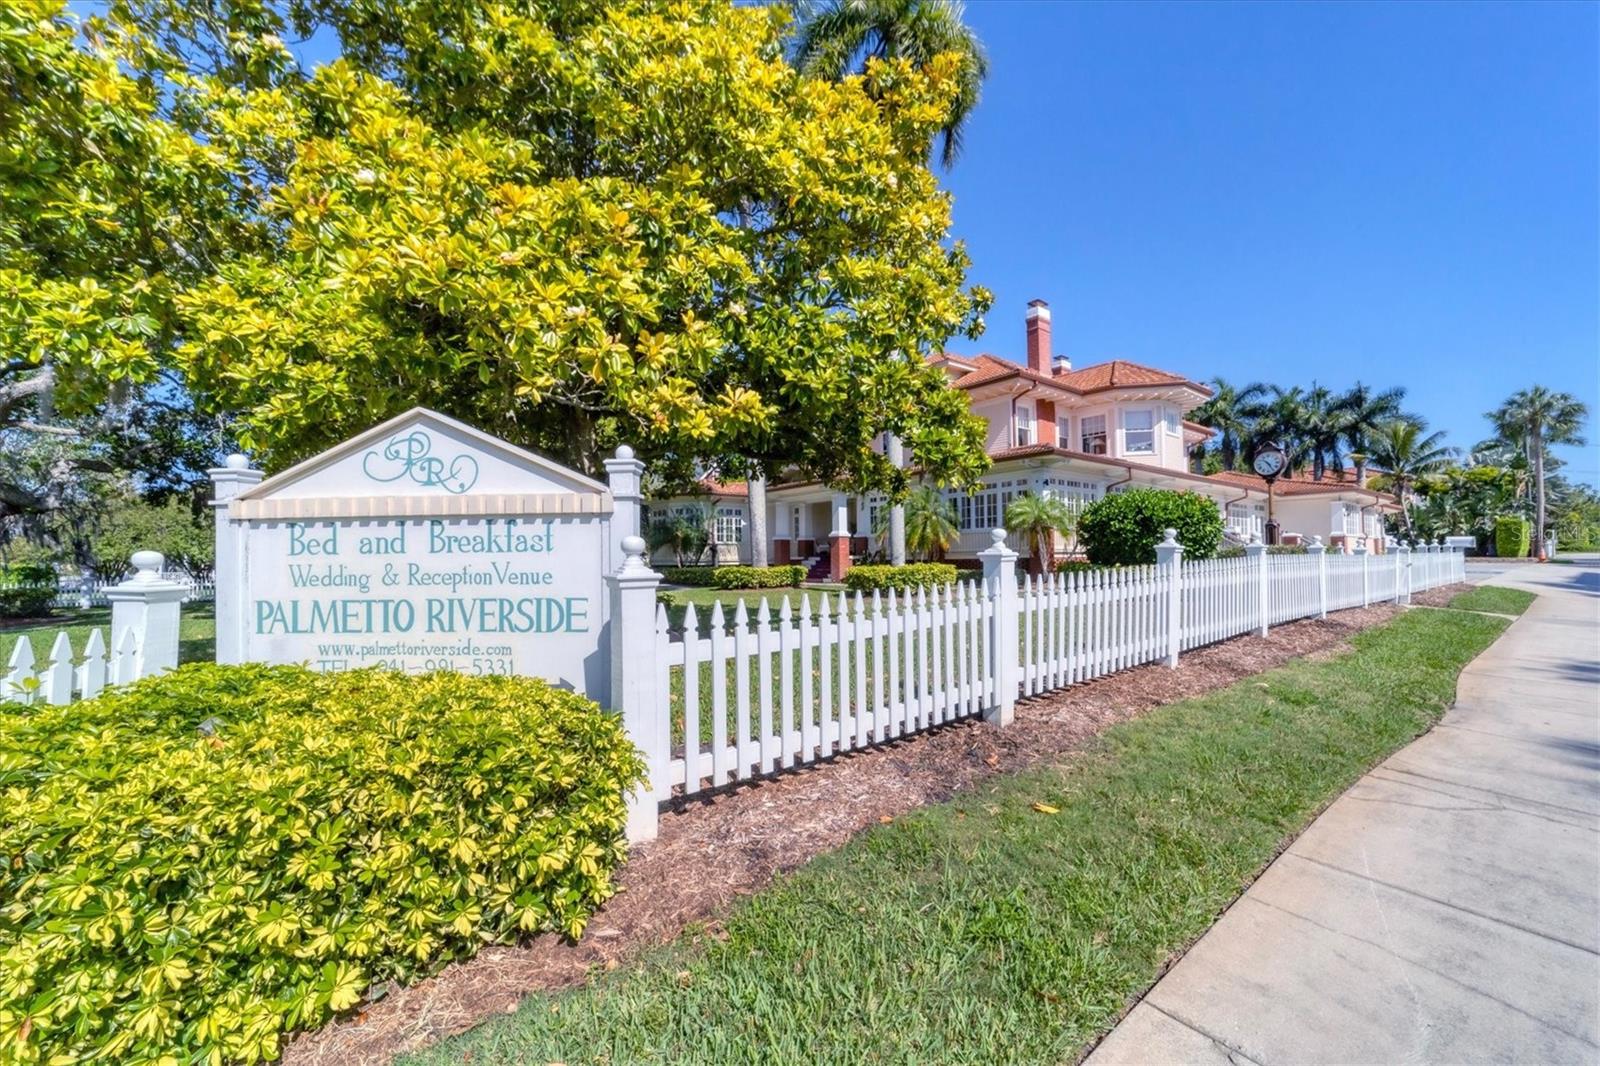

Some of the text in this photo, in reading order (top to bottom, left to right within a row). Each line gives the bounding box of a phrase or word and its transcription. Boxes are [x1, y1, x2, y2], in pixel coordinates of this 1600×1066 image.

[288, 518, 554, 556] Bed and Breakfast
[288, 563, 372, 594] Wedding
[382, 562, 400, 586] &
[255, 597, 589, 634] PALMETTO RIVERSIDE
[317, 638, 512, 660] www.palmettoriverside.com
